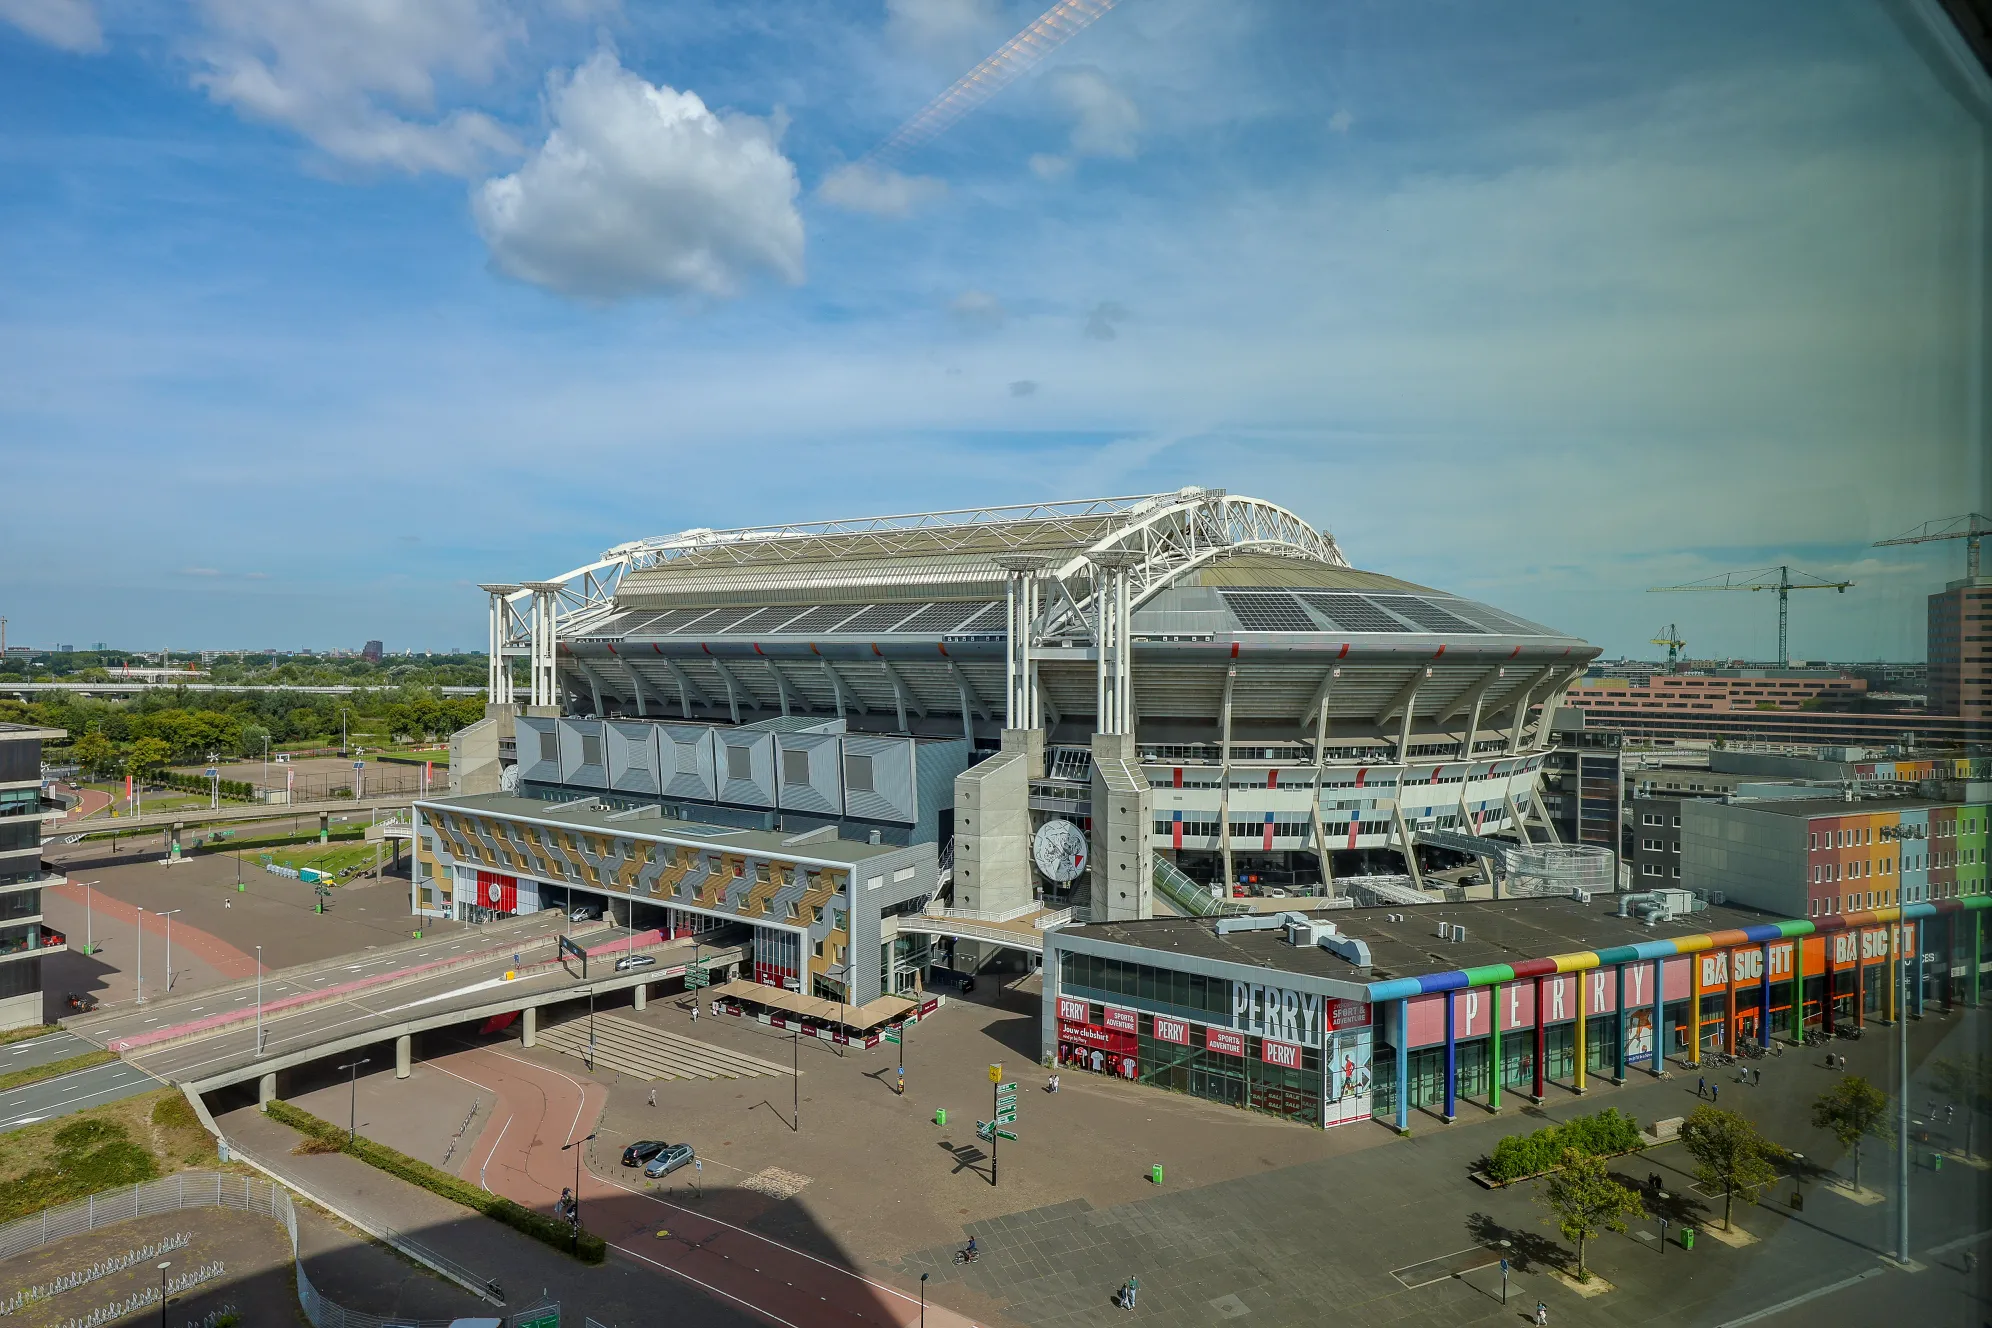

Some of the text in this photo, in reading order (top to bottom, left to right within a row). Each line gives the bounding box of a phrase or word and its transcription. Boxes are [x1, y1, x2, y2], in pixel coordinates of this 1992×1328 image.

[1836, 926, 1914, 964] BASIC FT
[1702, 945, 1793, 987] BASIC FIT
[1465, 963, 1644, 1036] PERRY
[1061, 1000, 1085, 1021] PERRY
[1232, 980, 1319, 1047] PERRY
[1062, 1023, 1109, 1042] Jouw clubshirt
[1106, 1018, 1135, 1031] ADVENTURE
[1158, 1020, 1184, 1042] PERRY
[1209, 1040, 1241, 1053] ADVENTURE
[1267, 1043, 1295, 1065] PERRY
[1284, 1092, 1301, 1101] SALE
[1284, 1101, 1301, 1110] SALE
